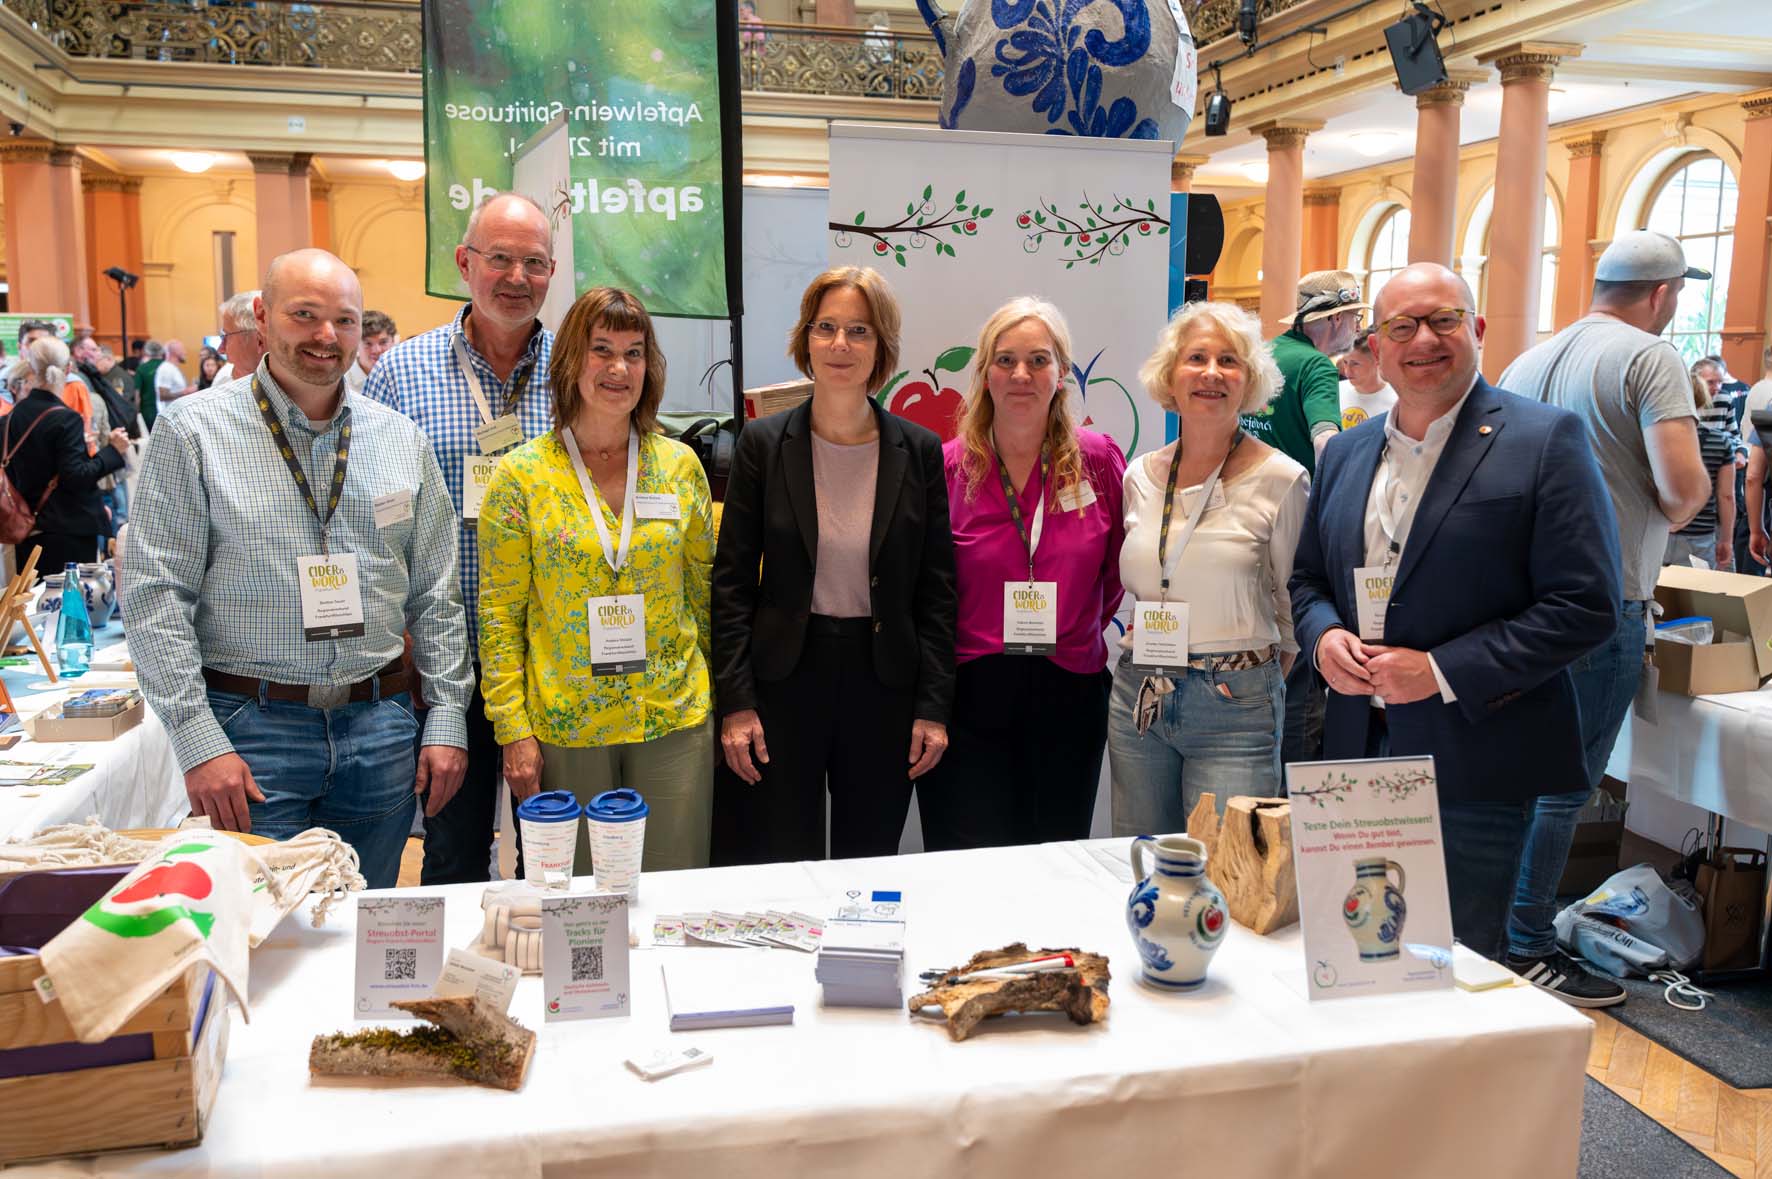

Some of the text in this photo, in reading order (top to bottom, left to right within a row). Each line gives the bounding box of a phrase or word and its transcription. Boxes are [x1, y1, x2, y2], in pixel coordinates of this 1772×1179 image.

[308, 564, 340, 577] CIDER
[311, 574, 348, 590] WORLD
[1013, 590, 1040, 600] CIDER
[598, 604, 628, 616] CIDER
[1015, 599, 1047, 612] WORLD
[601, 613, 635, 628] WORLD
[1144, 610, 1171, 620] CIDER
[1145, 620, 1178, 634] WORLD
[1303, 821, 1328, 832] Teste
[1329, 820, 1352, 830] Dein
[1358, 830, 1369, 838] Du
[1329, 843, 1340, 851] Du
[367, 928, 437, 937] Streuobst-Portal
[566, 927, 592, 937] Tracks
